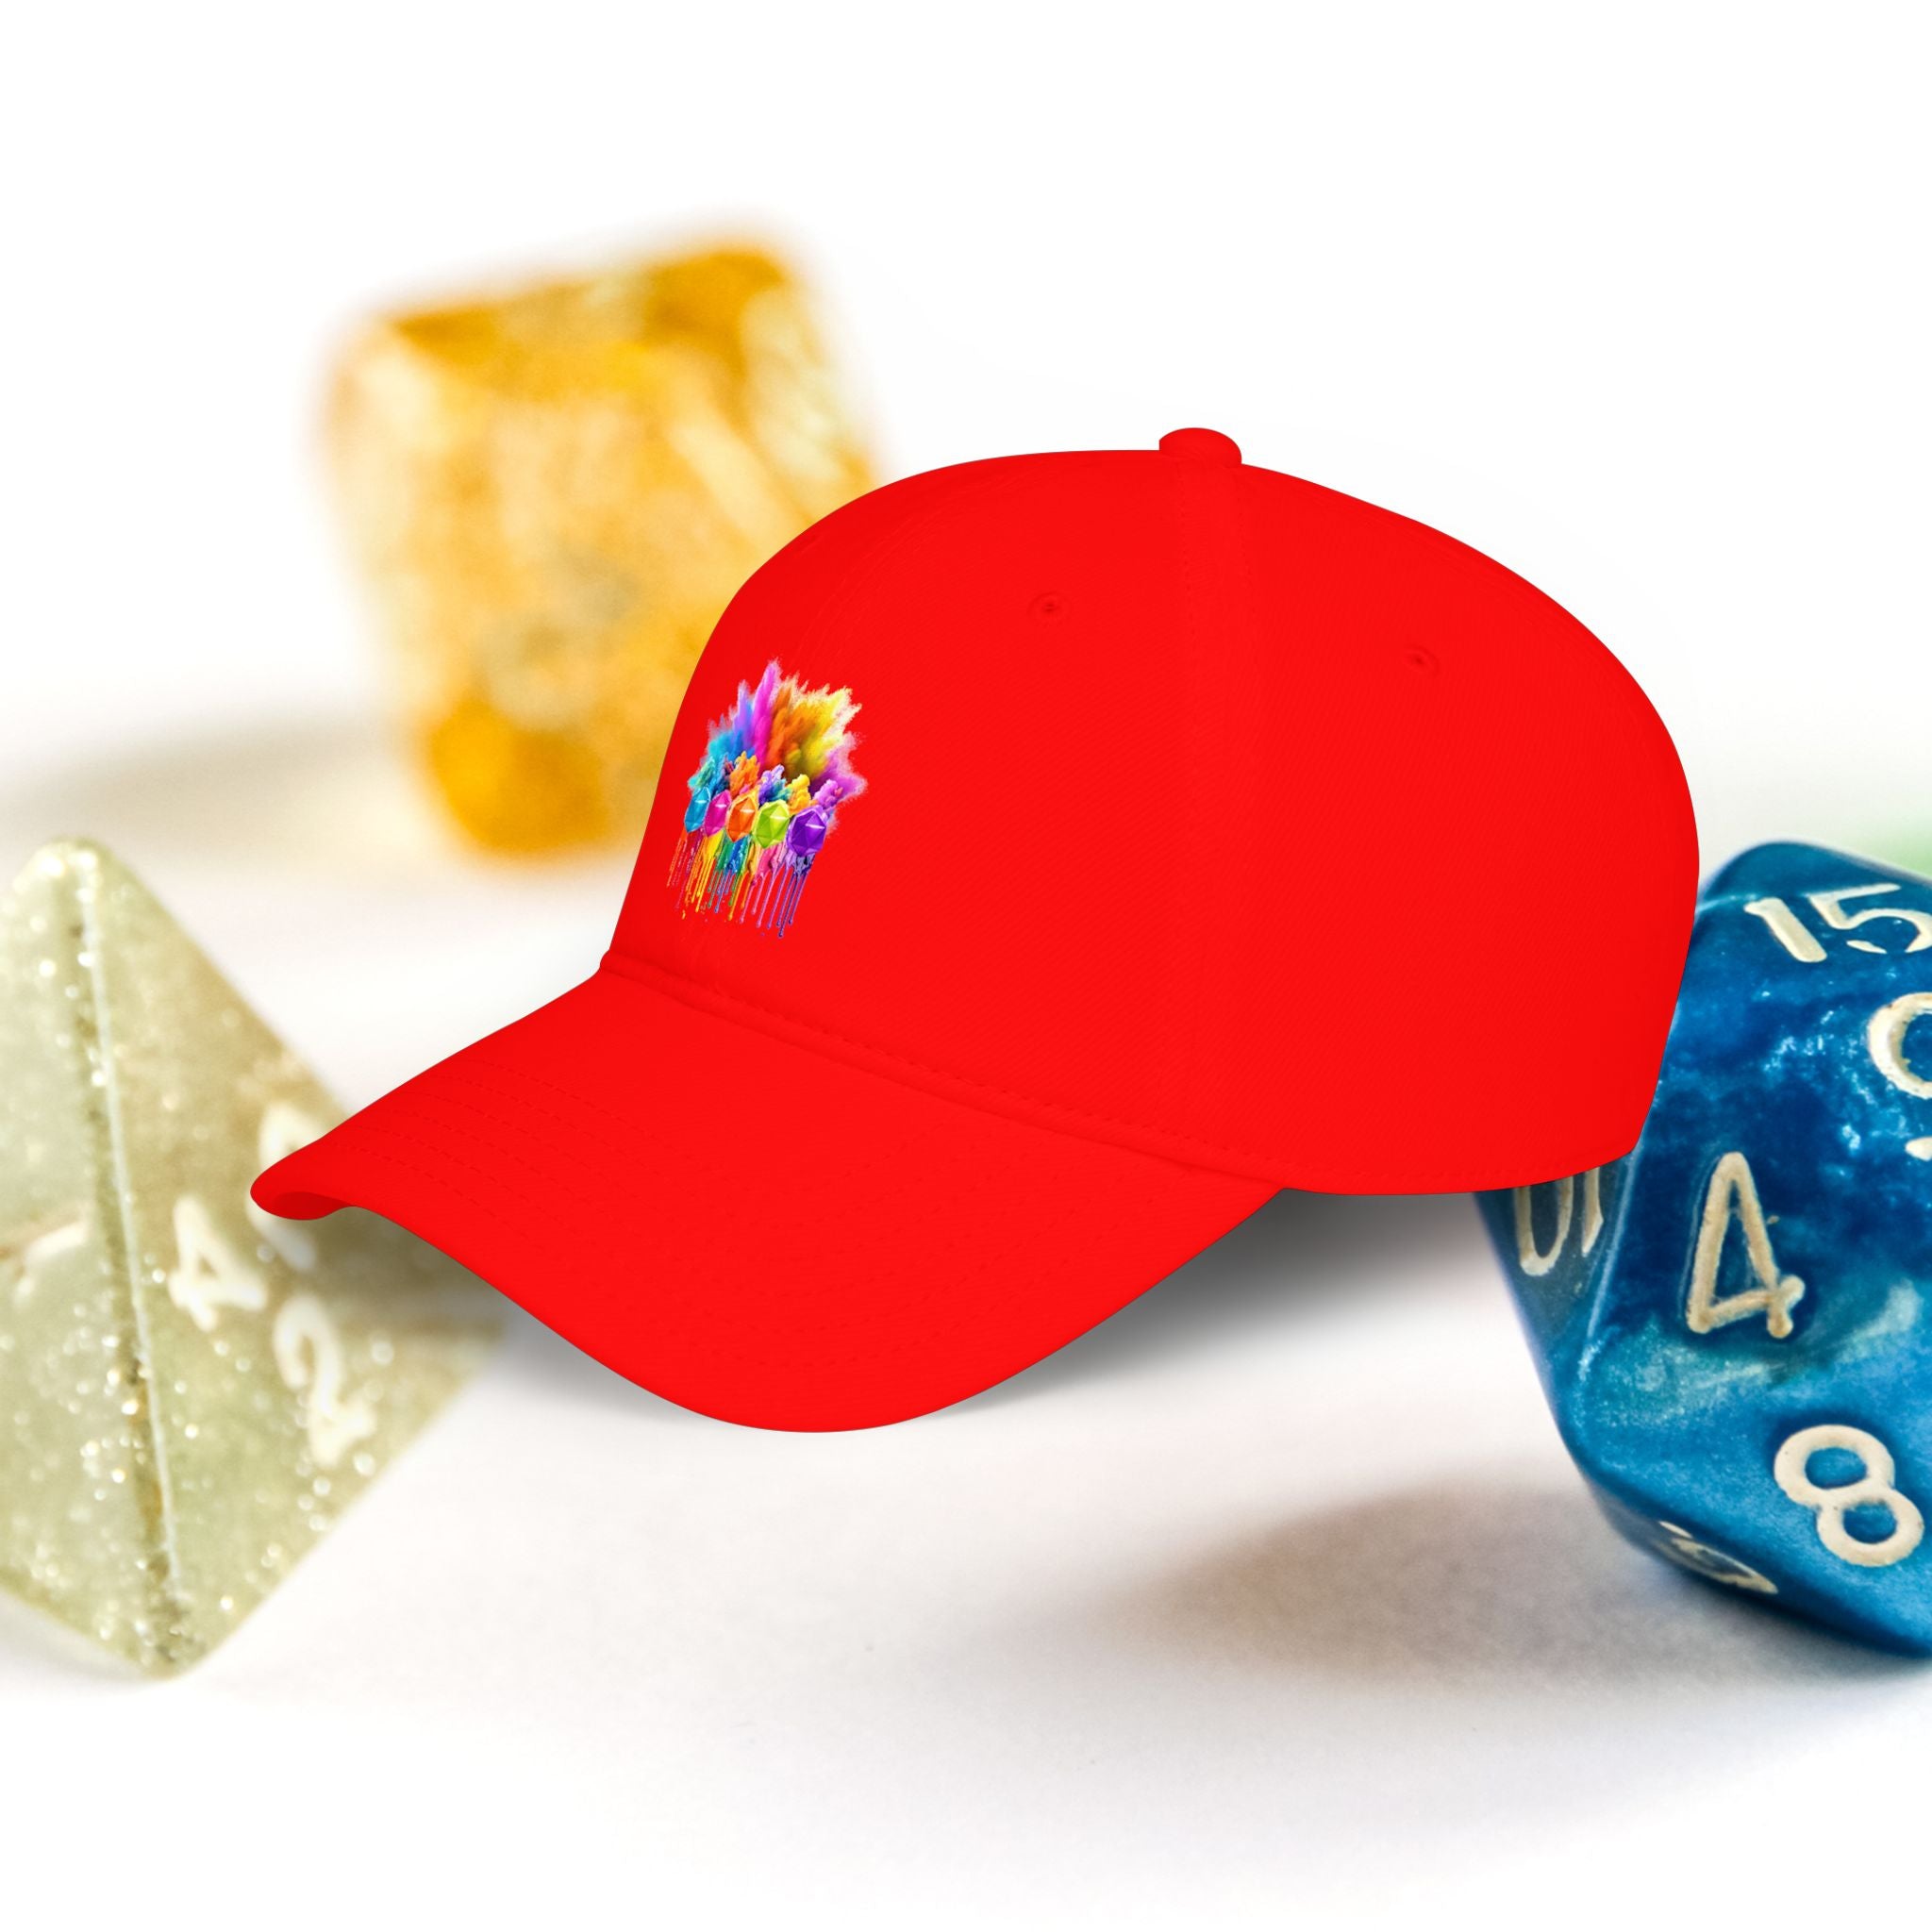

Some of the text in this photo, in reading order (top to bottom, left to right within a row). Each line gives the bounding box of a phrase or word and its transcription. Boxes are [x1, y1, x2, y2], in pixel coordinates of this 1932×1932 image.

[1743, 883, 1932, 963] 15
[167, 1195, 268, 1332] 4
[1686, 1151, 1806, 1339] 4
[274, 1294, 375, 1468] 2
[1774, 1424, 1924, 1568] 8
